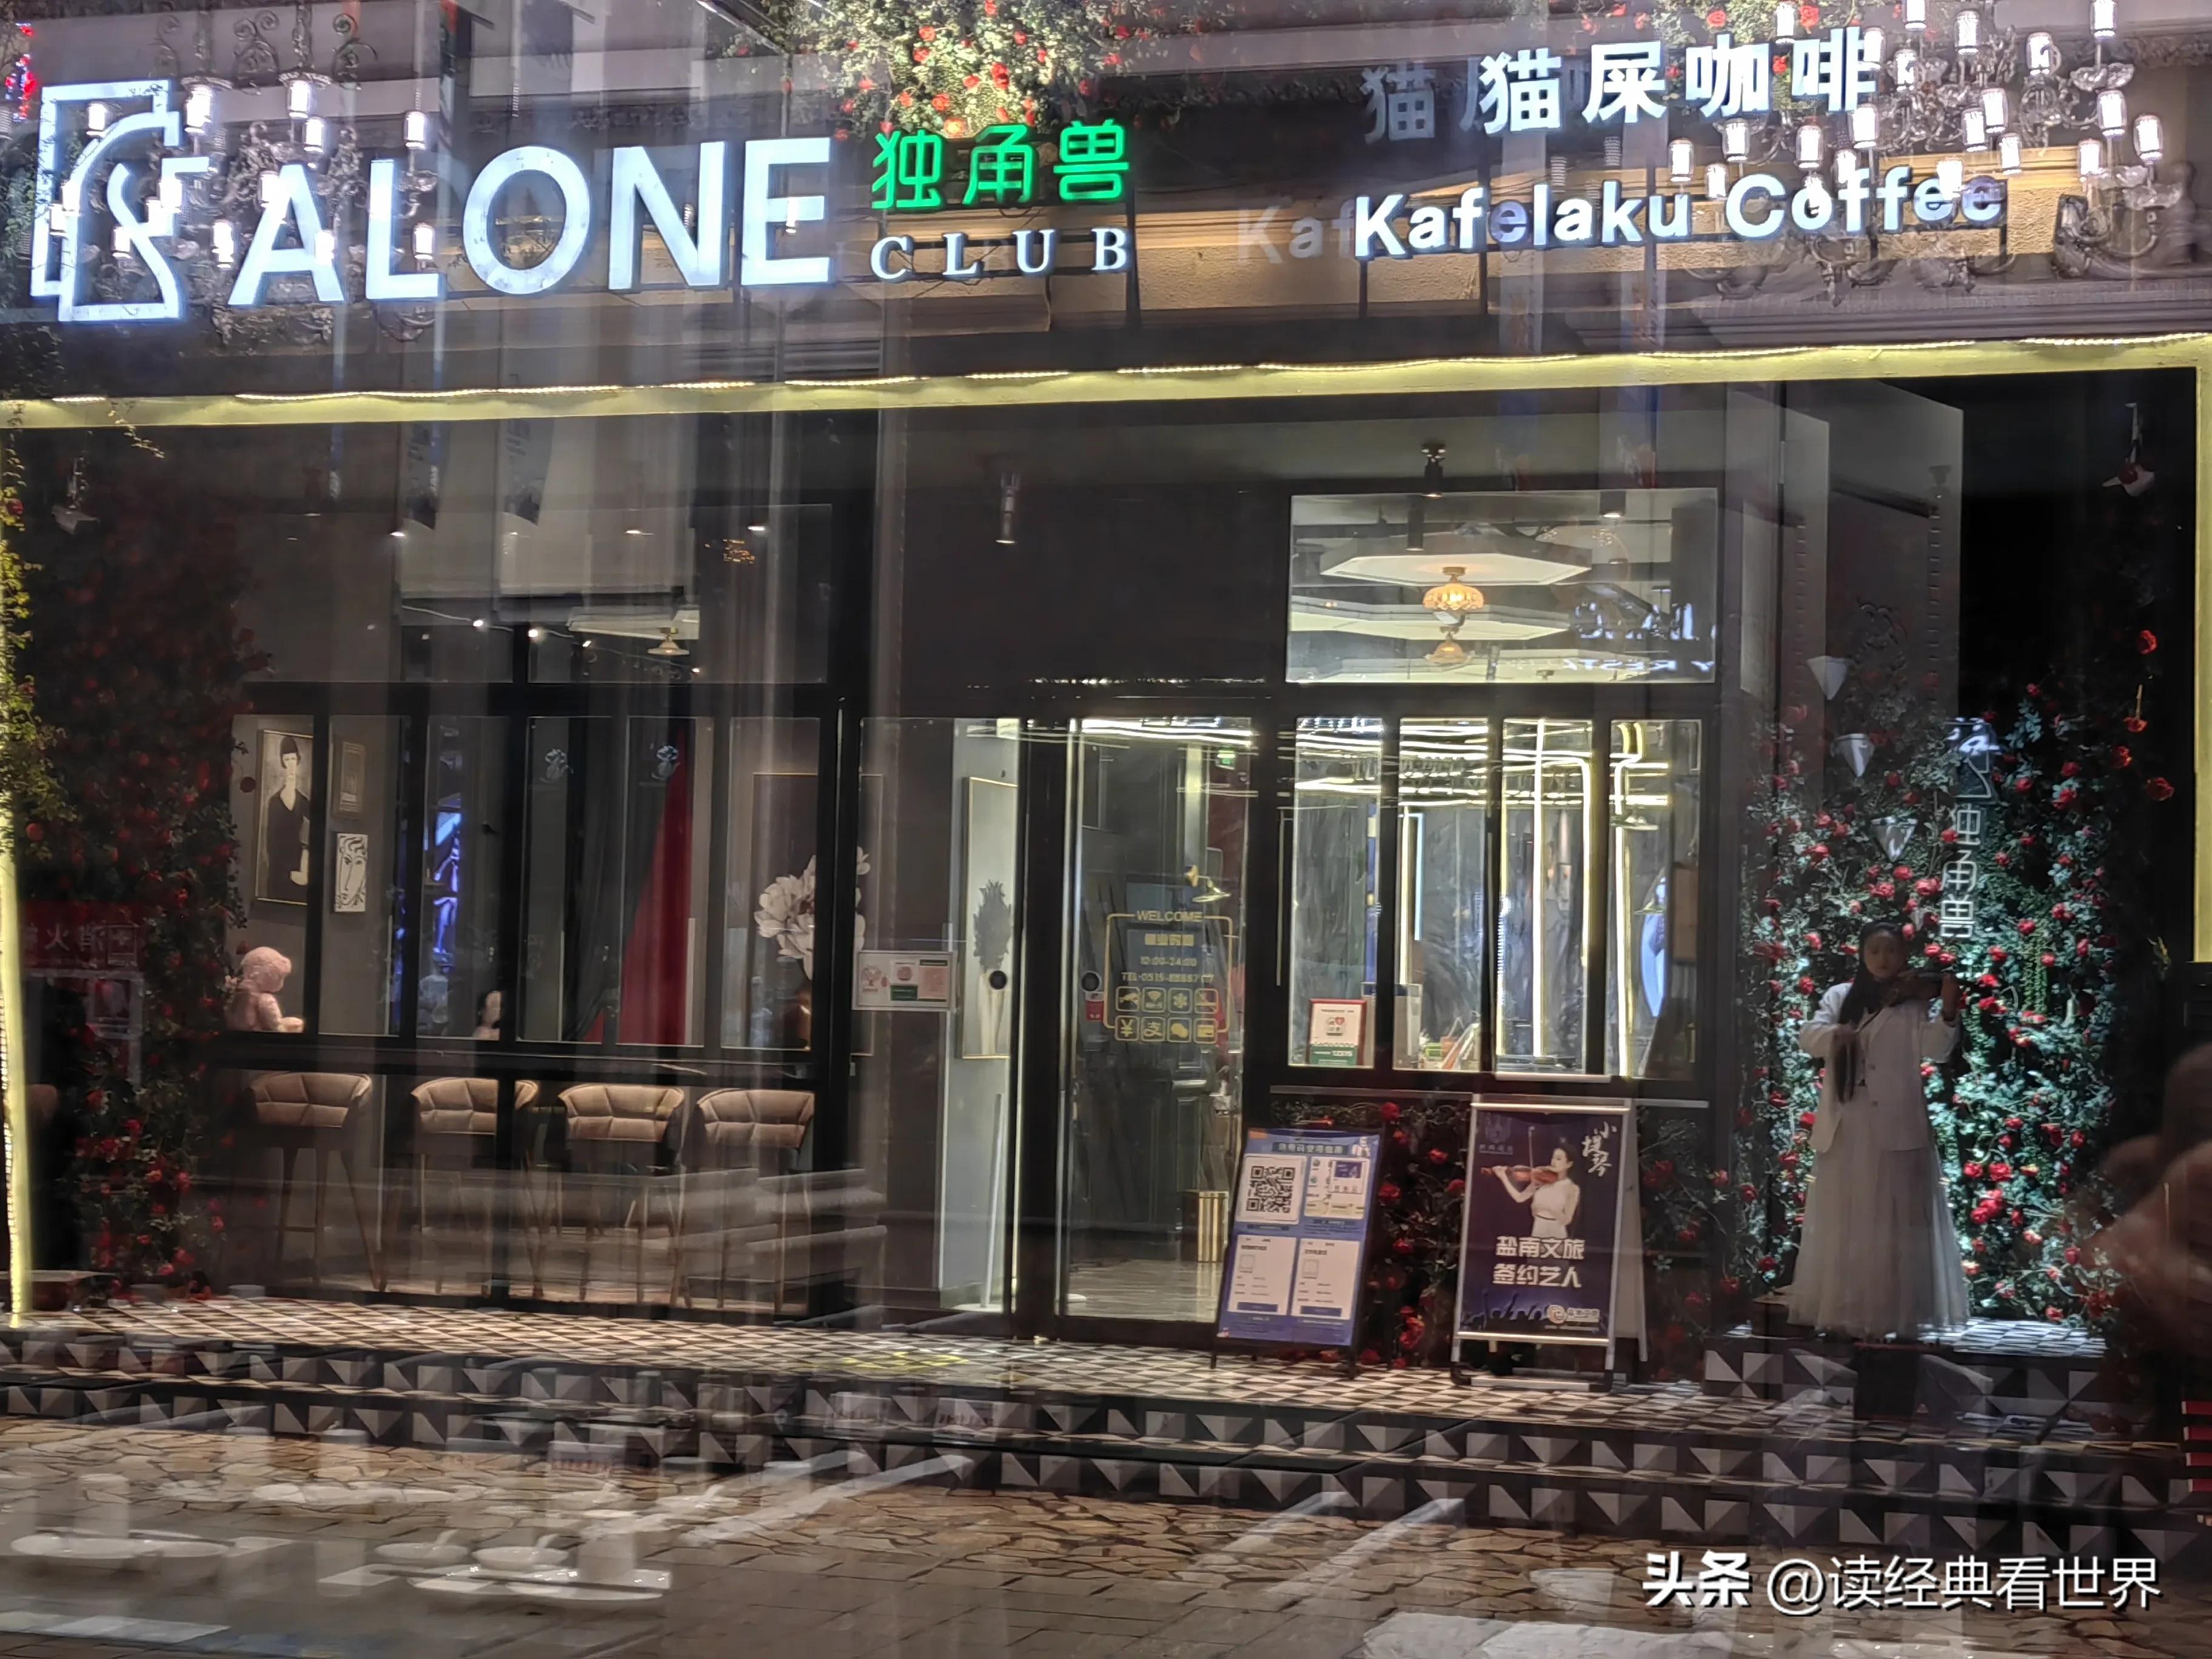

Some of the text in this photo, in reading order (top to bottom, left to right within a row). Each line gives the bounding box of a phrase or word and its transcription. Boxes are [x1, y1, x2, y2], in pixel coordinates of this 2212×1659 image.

[1478, 25, 1877, 135] 猫屎咖啡
[871, 119, 1130, 210] 独角兽
[228, 138, 832, 307] ALONE
[1355, 166, 2005, 258] Kafelaku Coffee
[870, 228, 1129, 283] CLUB
[1136, 910, 1203, 922] WELCOME
[1492, 1263, 1582, 1288] 签约艺人
[1495, 1236, 1586, 1260] 盐南文旅
